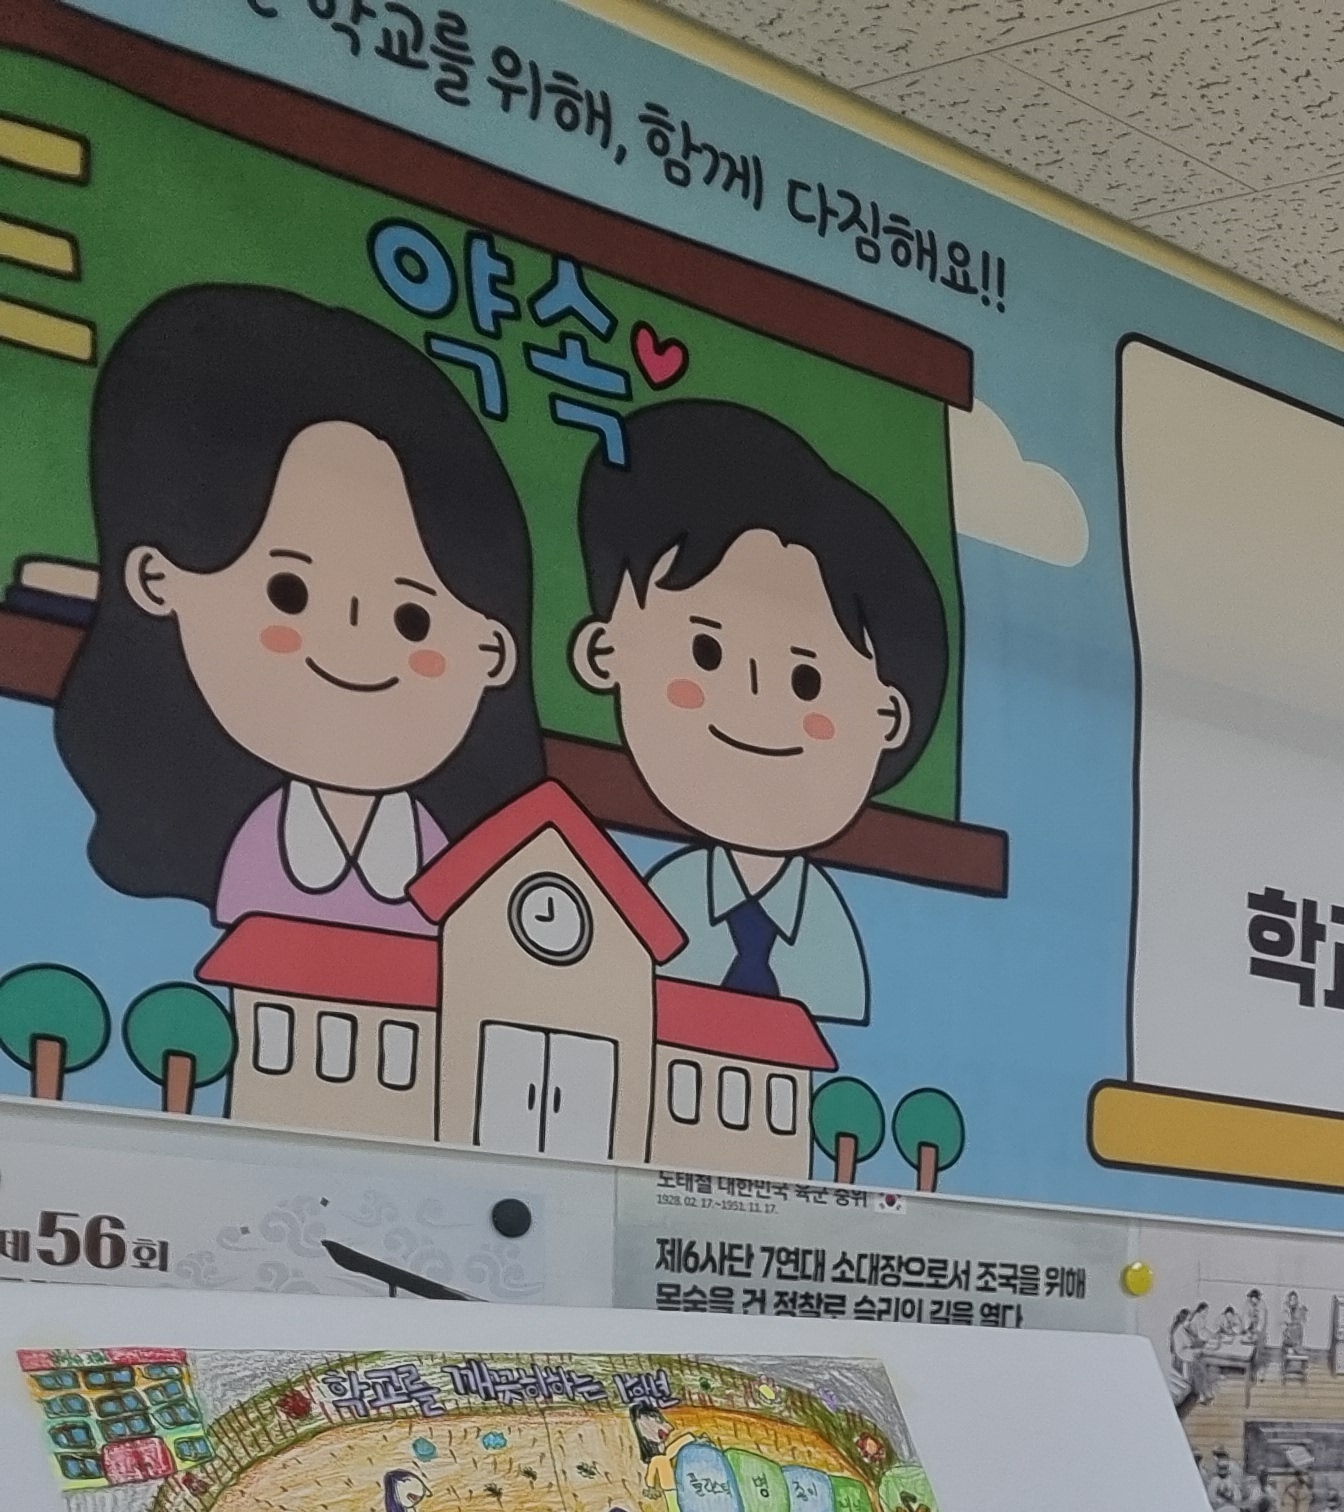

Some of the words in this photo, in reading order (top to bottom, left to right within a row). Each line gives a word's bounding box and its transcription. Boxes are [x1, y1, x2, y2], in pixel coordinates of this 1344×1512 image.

[486, 45, 629, 165] 위해,
[637, 103, 765, 213] 함께
[786, 176, 1007, 314] 다짐해요!!
[368, 216, 633, 471] 약속
[655, 1237, 754, 1277] 제6사단
[760, 1245, 826, 1282] 7연대
[831, 1251, 971, 1291] 소대장으로서
[975, 1261, 1040, 1296] 조국을
[1045, 1266, 1086, 1299] 위해
[322, 1363, 446, 1418] 학교를
[752, 1475, 770, 1498] 병
